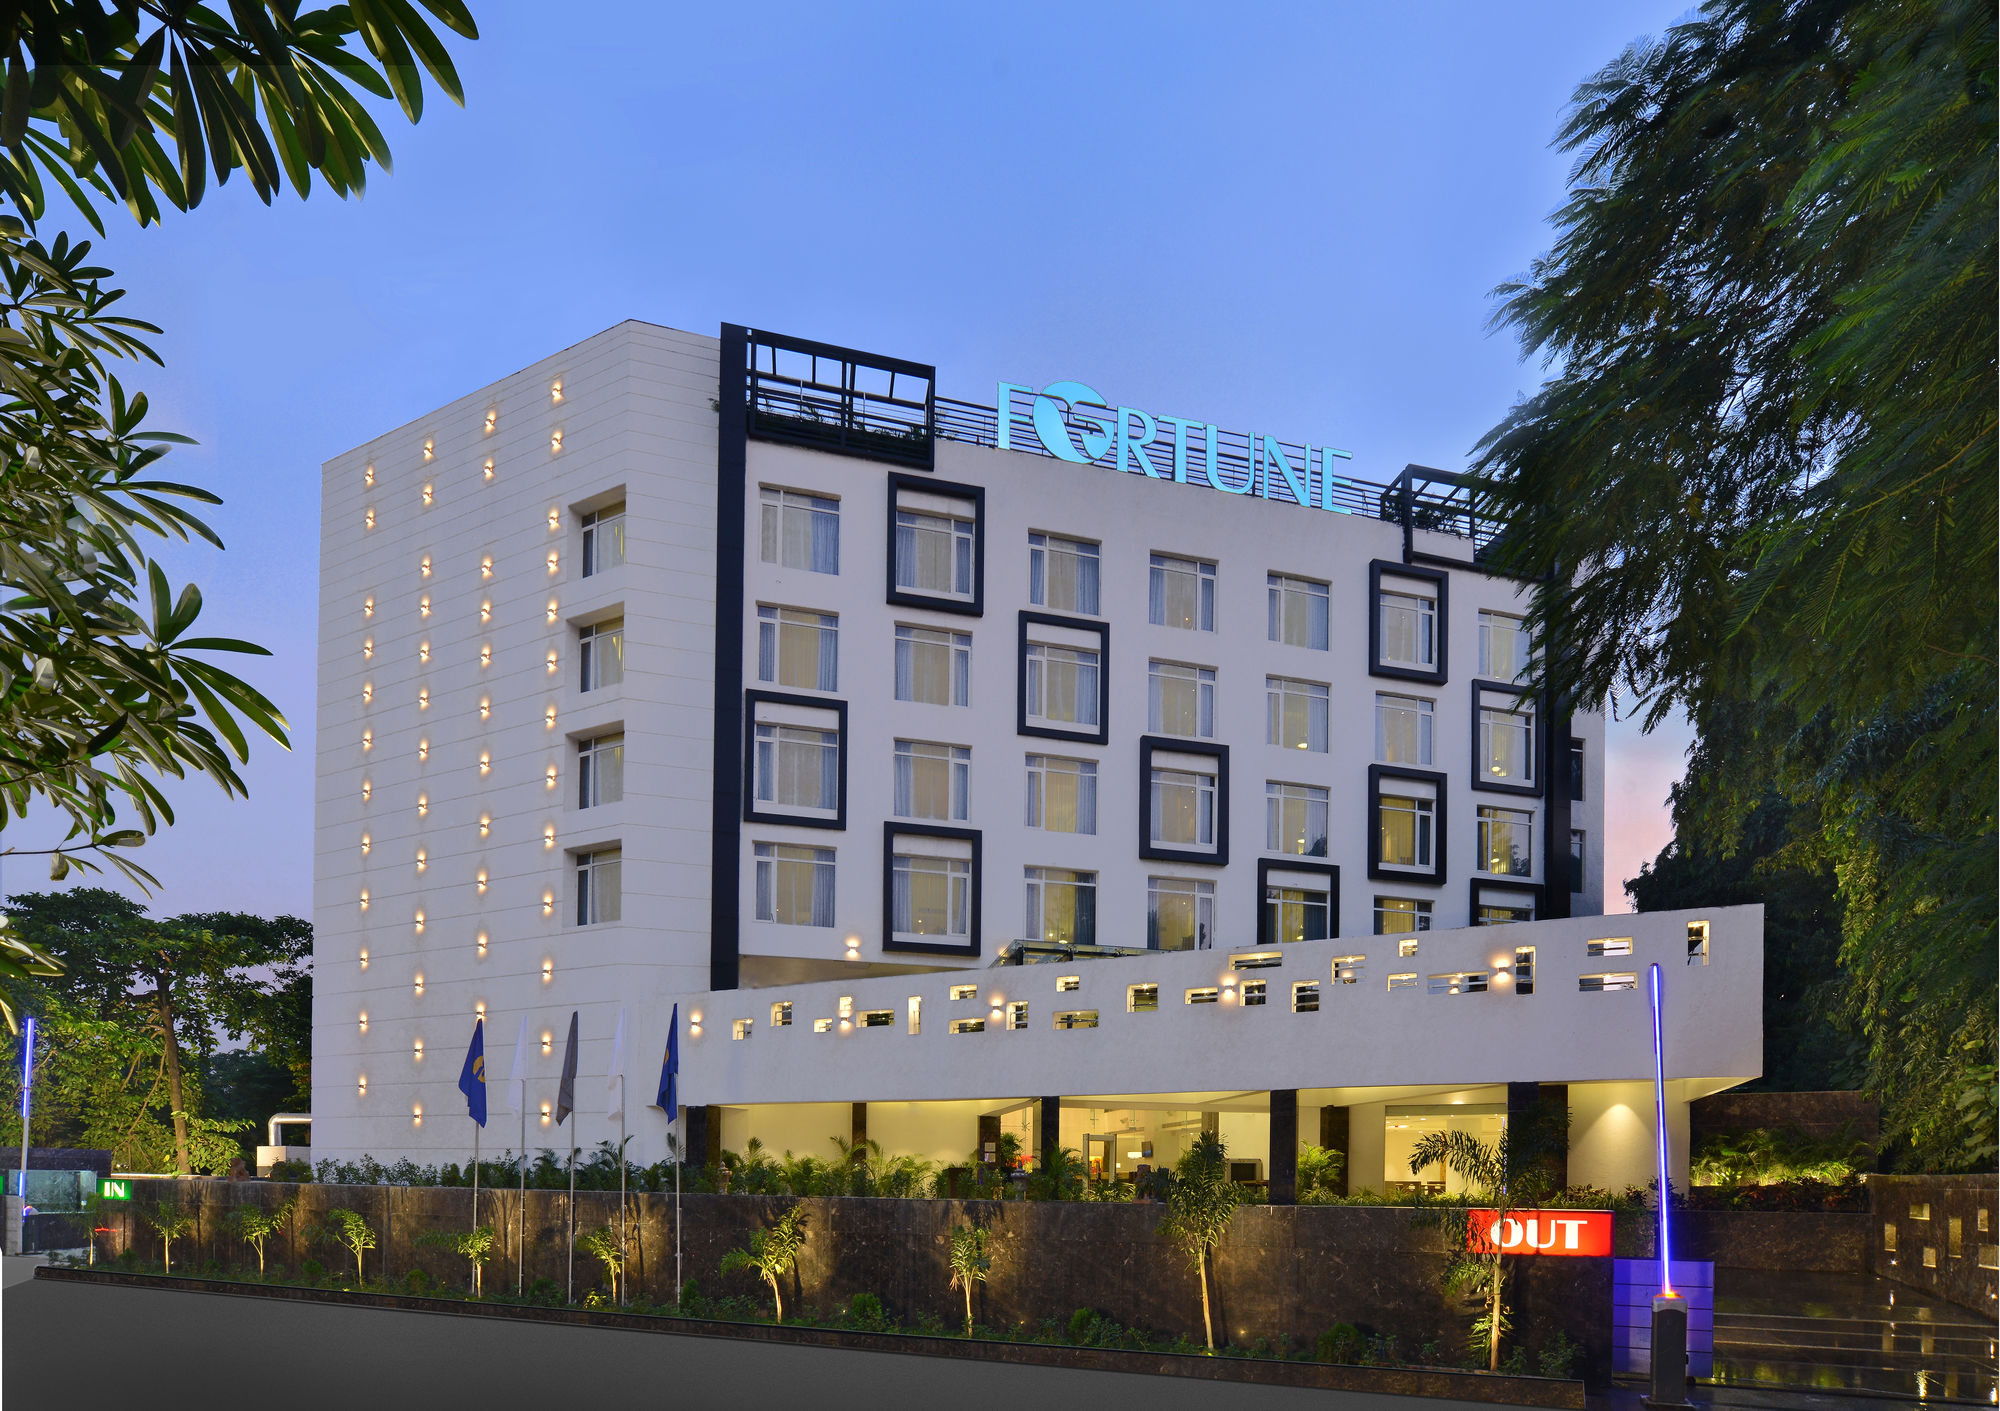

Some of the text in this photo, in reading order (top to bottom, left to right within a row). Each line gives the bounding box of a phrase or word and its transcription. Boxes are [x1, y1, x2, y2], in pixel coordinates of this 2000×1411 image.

[998, 380, 1353, 515] FORTUNE
[103, 1182, 125, 1197] IN
[1490, 1218, 1588, 1249] OUT
